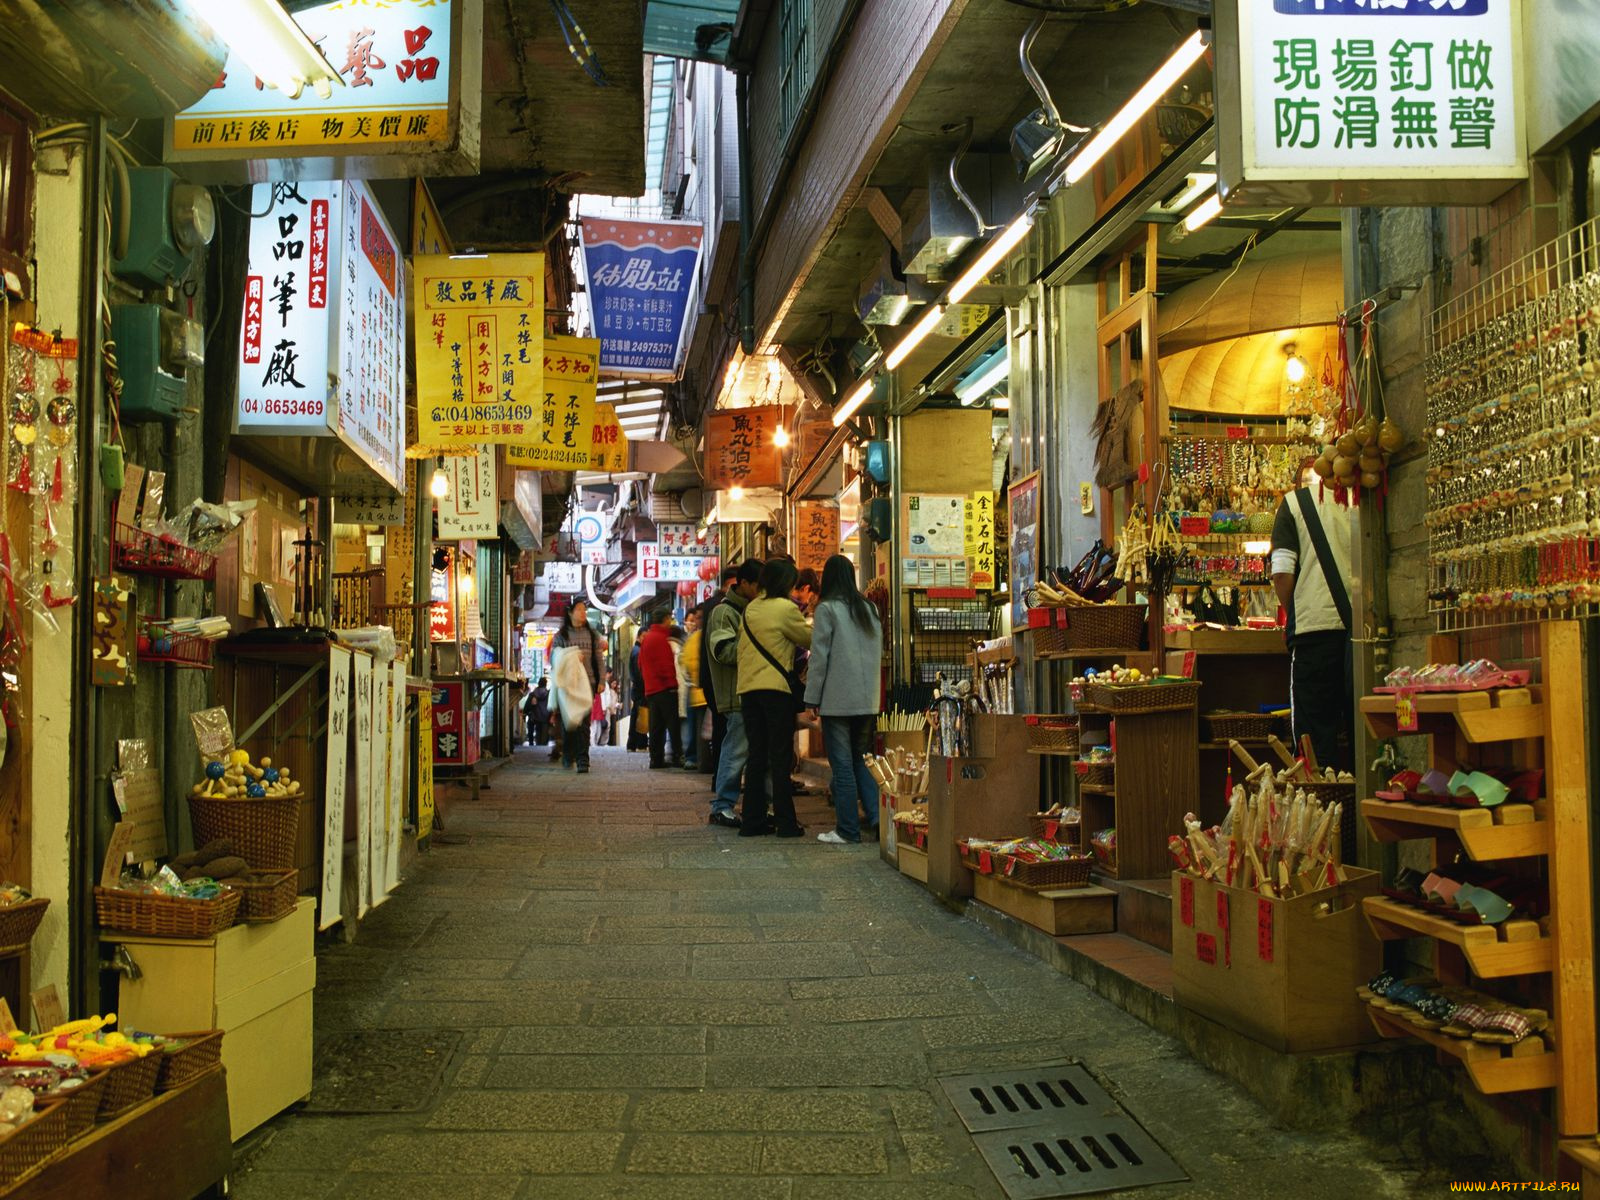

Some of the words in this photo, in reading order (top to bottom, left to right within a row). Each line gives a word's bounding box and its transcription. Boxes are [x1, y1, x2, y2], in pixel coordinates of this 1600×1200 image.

[312, 25, 439, 88] 藝品
[1273, 38, 1494, 91] 現場釘做
[192, 118, 300, 143] 前店後店
[321, 115, 430, 138] 物美價廉
[1274, 96, 1495, 149] 防滑無聲
[244, 278, 262, 360] 用久方知
[432, 313, 446, 349] 好筆
[517, 314, 532, 364] 不掉毛
[451, 342, 464, 402] 中等價格
[477, 321, 493, 396] 用久方知
[241, 399, 323, 416] (04)8653469
[439, 423, 524, 436] 二支以上可郵寄
[563, 395, 580, 448] 不掉毛
[729, 414, 753, 479] 魚丸伯仔
[977, 495, 993, 572] 金瓜石九份
